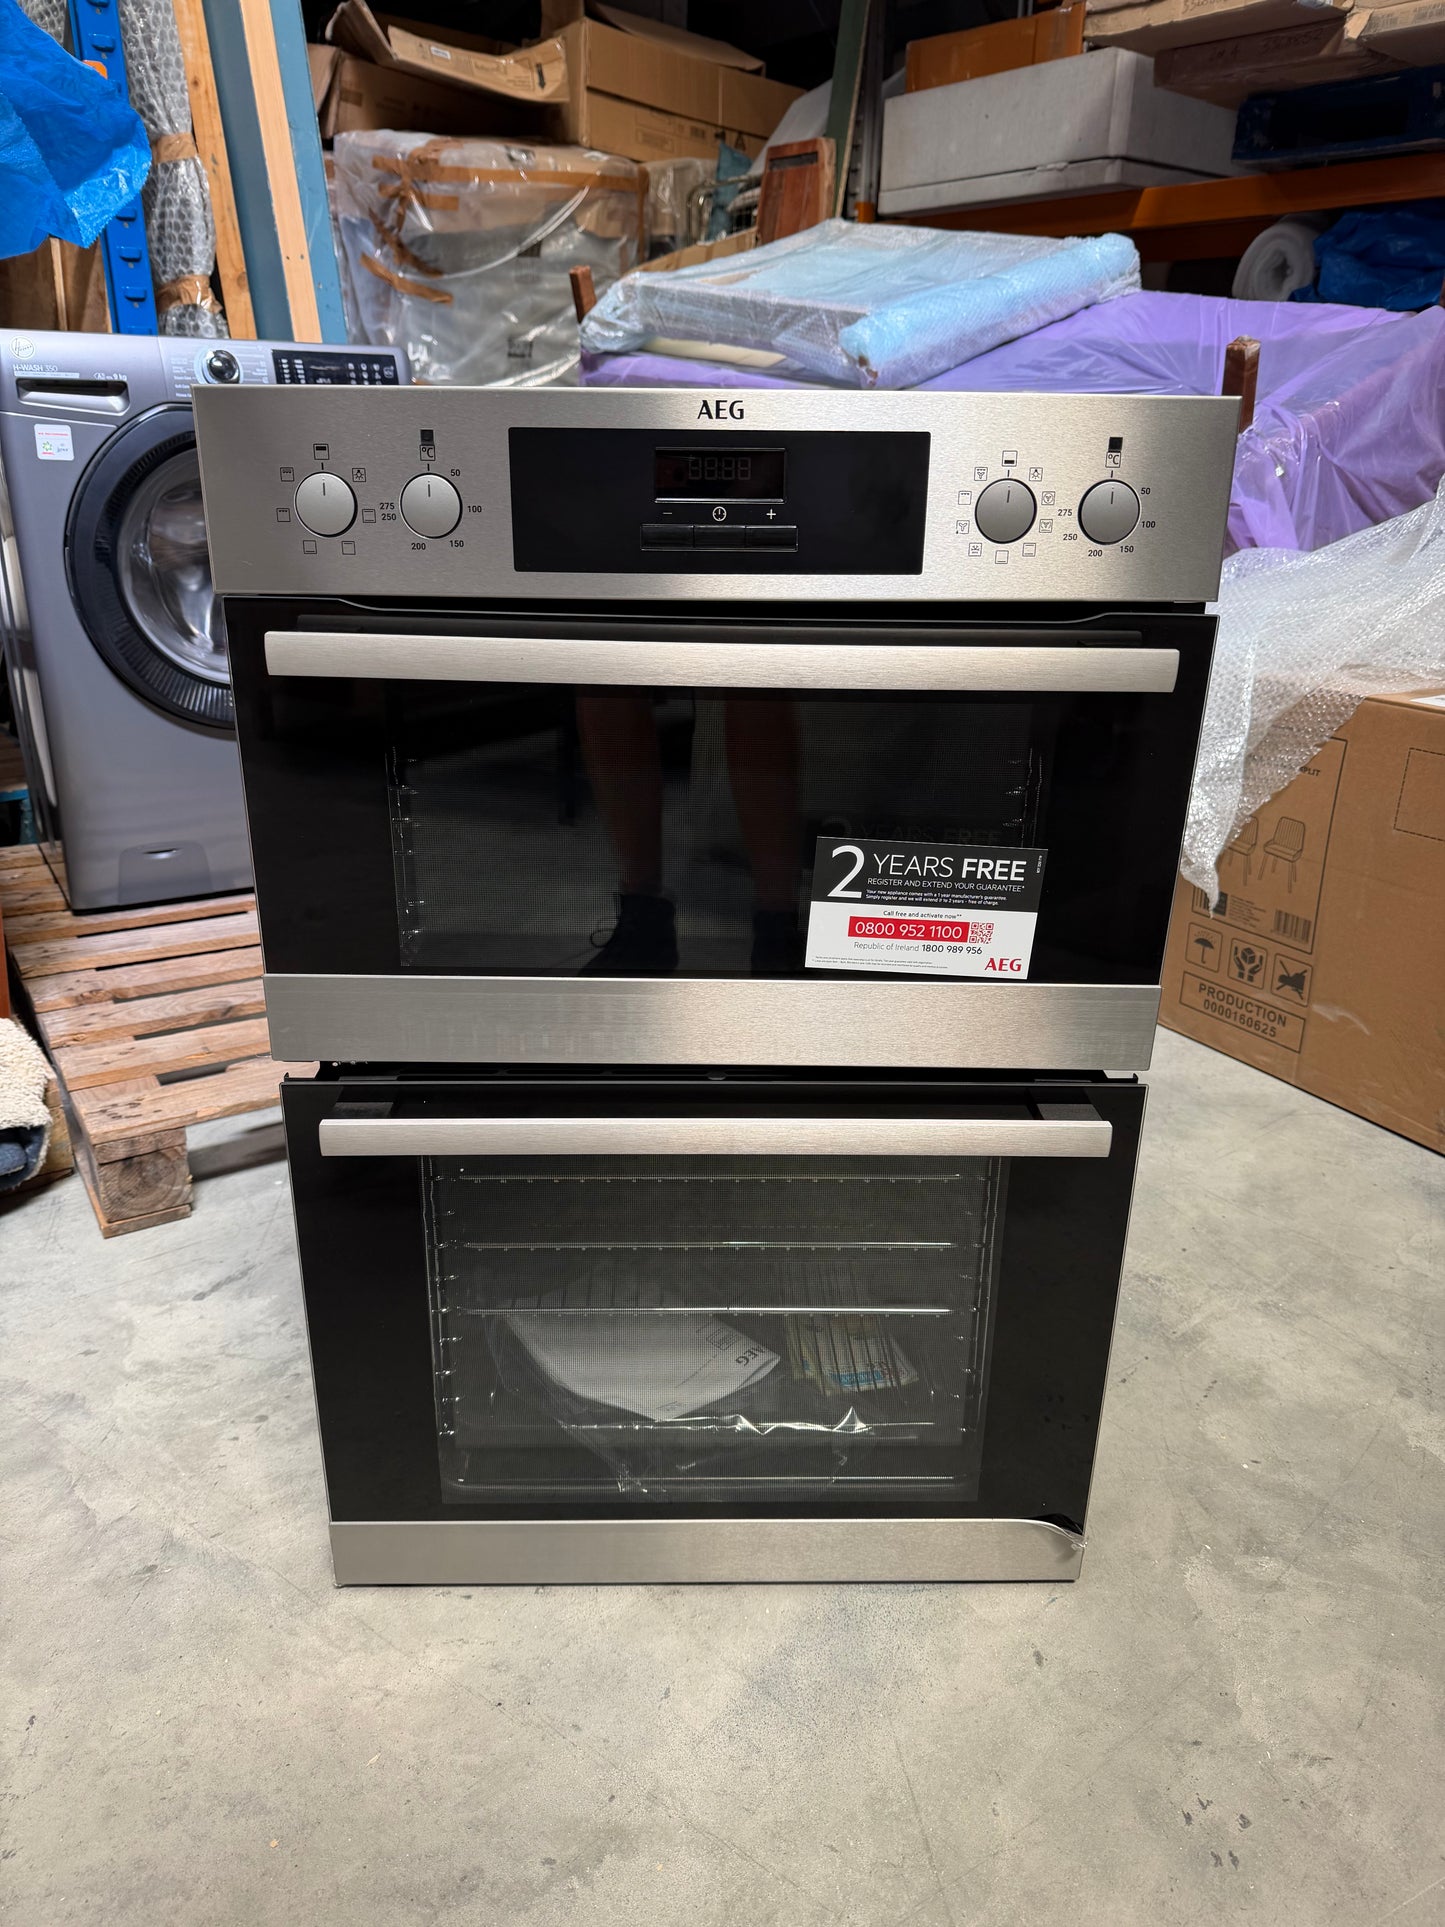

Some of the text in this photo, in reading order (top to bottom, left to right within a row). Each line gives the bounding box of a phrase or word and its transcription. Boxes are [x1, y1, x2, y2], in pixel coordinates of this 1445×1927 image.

[697, 400, 745, 420] AEG
[450, 469, 461, 477] 50
[379, 502, 395, 510] 275
[467, 505, 482, 513] 100
[381, 513, 397, 521] 250
[1057, 509, 1073, 517] 275
[1141, 521, 1156, 529] 100
[411, 542, 426, 551] 200
[450, 540, 464, 548] 150
[1120, 545, 1134, 553] 150
[827, 844, 865, 899] 2
[873, 853, 954, 878] YEARS
[961, 858, 1027, 881] FREE
[867, 877, 903, 886] REGISTER
[904, 879, 921, 887] AND
[922, 880, 953, 889] EXTEND
[954, 882, 975, 890] YOUR
[855, 922, 962, 939] 0800 952 1100
[854, 941, 884, 951] Republic
[895, 943, 919, 951] Ireland
[922, 944, 944, 953] 1800
[946, 946, 964, 954] 989
[966, 947, 982, 955] 956
[984, 957, 1022, 972] AEG
[1198, 983, 1287, 1027] PRODUCTION
[1203, 999, 1277, 1038] 0000160625
